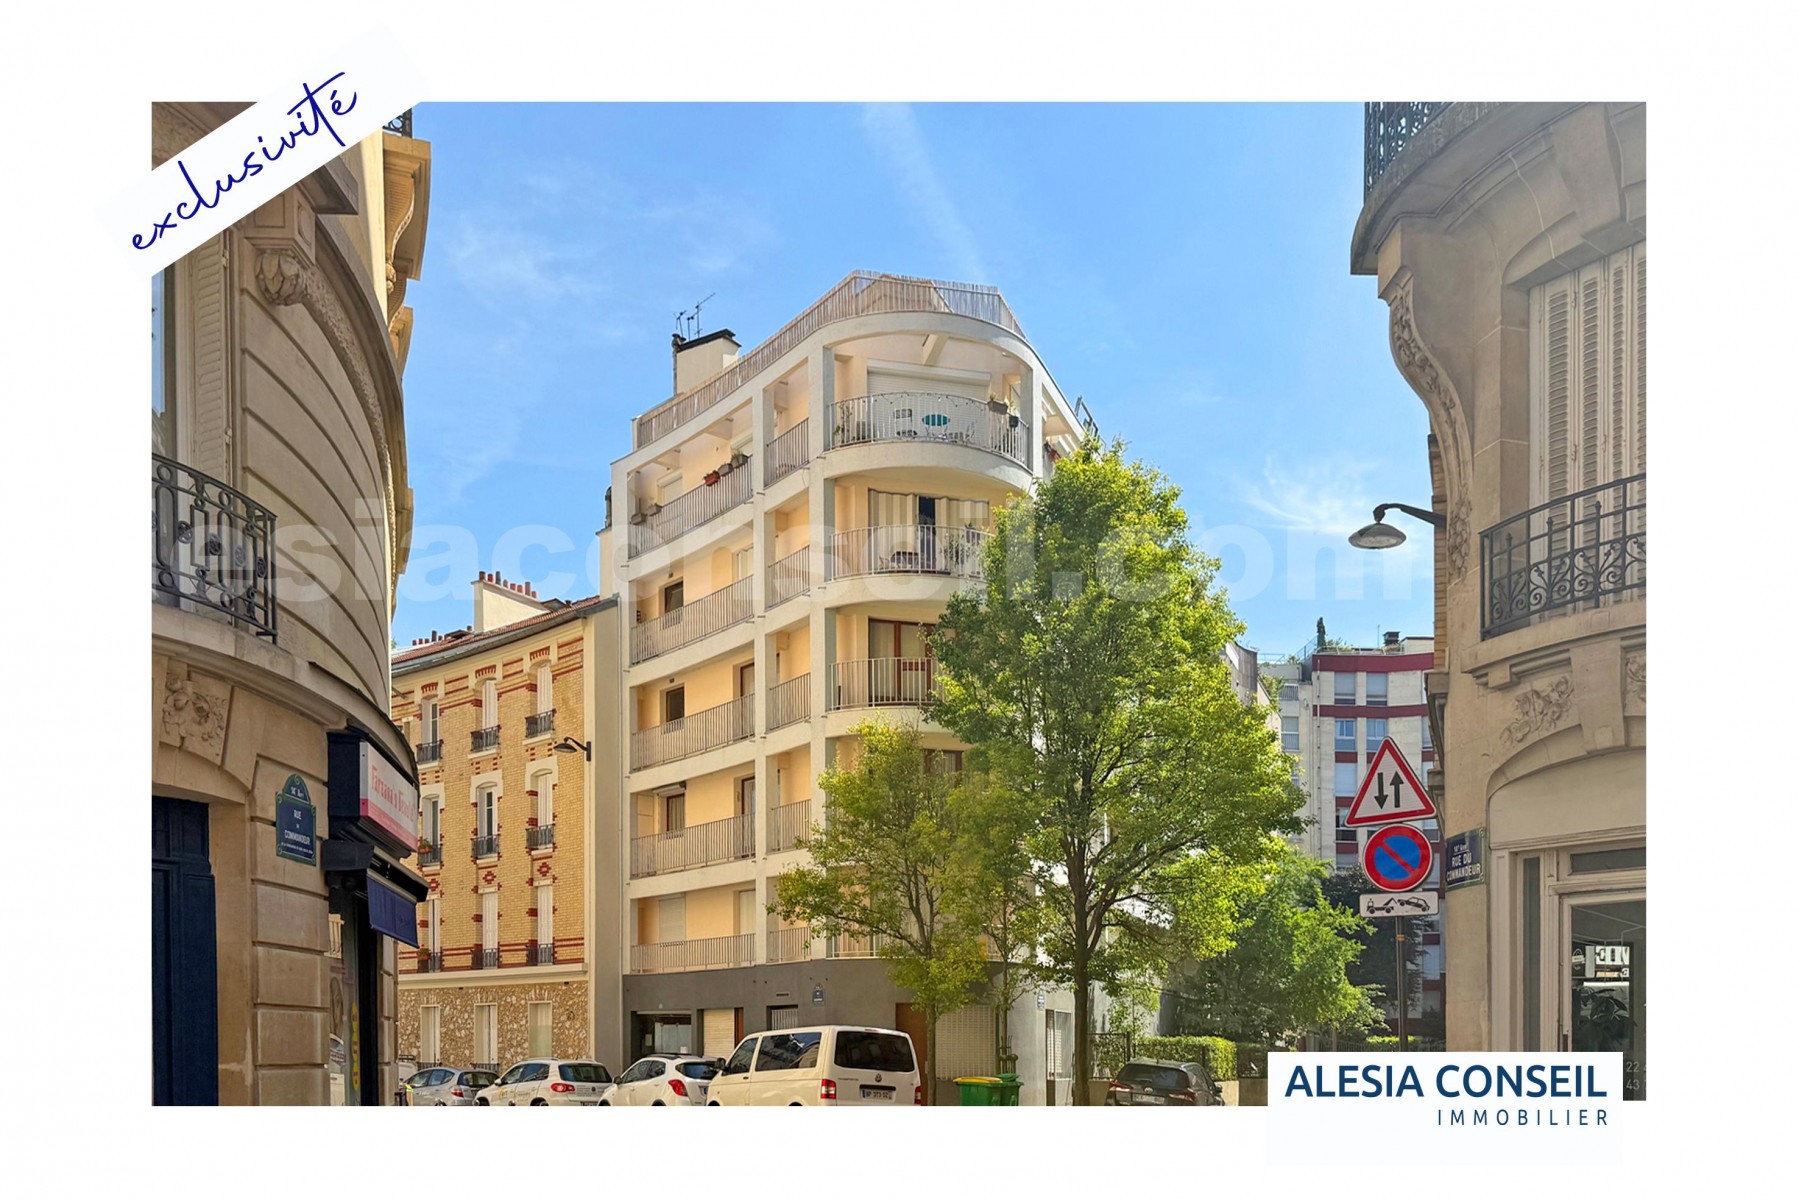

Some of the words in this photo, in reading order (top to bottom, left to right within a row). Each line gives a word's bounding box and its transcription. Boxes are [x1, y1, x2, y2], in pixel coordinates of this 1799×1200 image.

[294, 809, 302, 820] RUE
[1451, 854, 1462, 867] RUE
[1462, 852, 1472, 864] DU
[1446, 863, 1481, 881] COMMANDEUR
[1626, 1061, 1640, 1073] 22
[1626, 1079, 1640, 1091] 43
